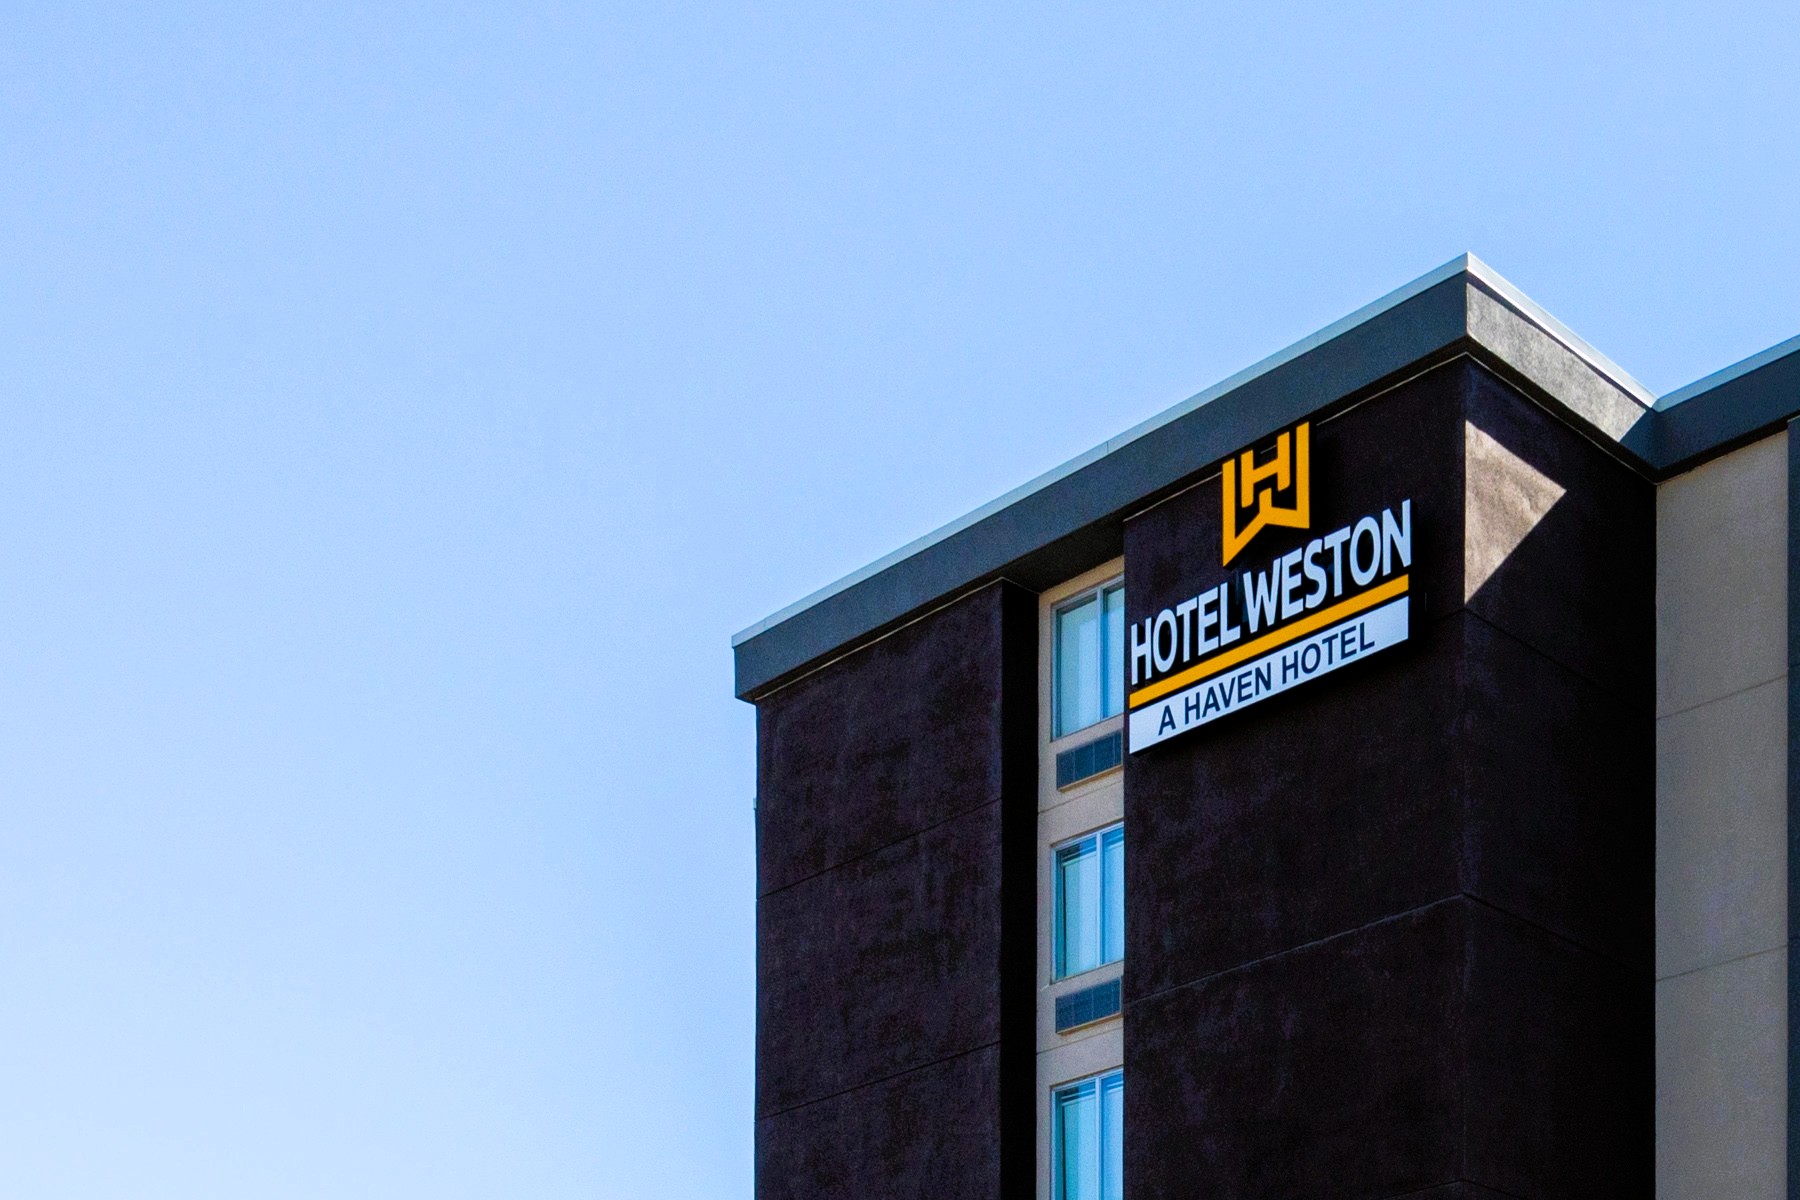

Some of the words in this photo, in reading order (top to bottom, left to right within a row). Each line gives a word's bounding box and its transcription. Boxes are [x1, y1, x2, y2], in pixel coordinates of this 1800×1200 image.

[1130, 581, 1241, 685] HOTEL
[1243, 498, 1412, 634] WESTON
[1157, 704, 1177, 737] A
[1184, 662, 1273, 726] HAVEN
[1281, 621, 1376, 685] HOTEL
